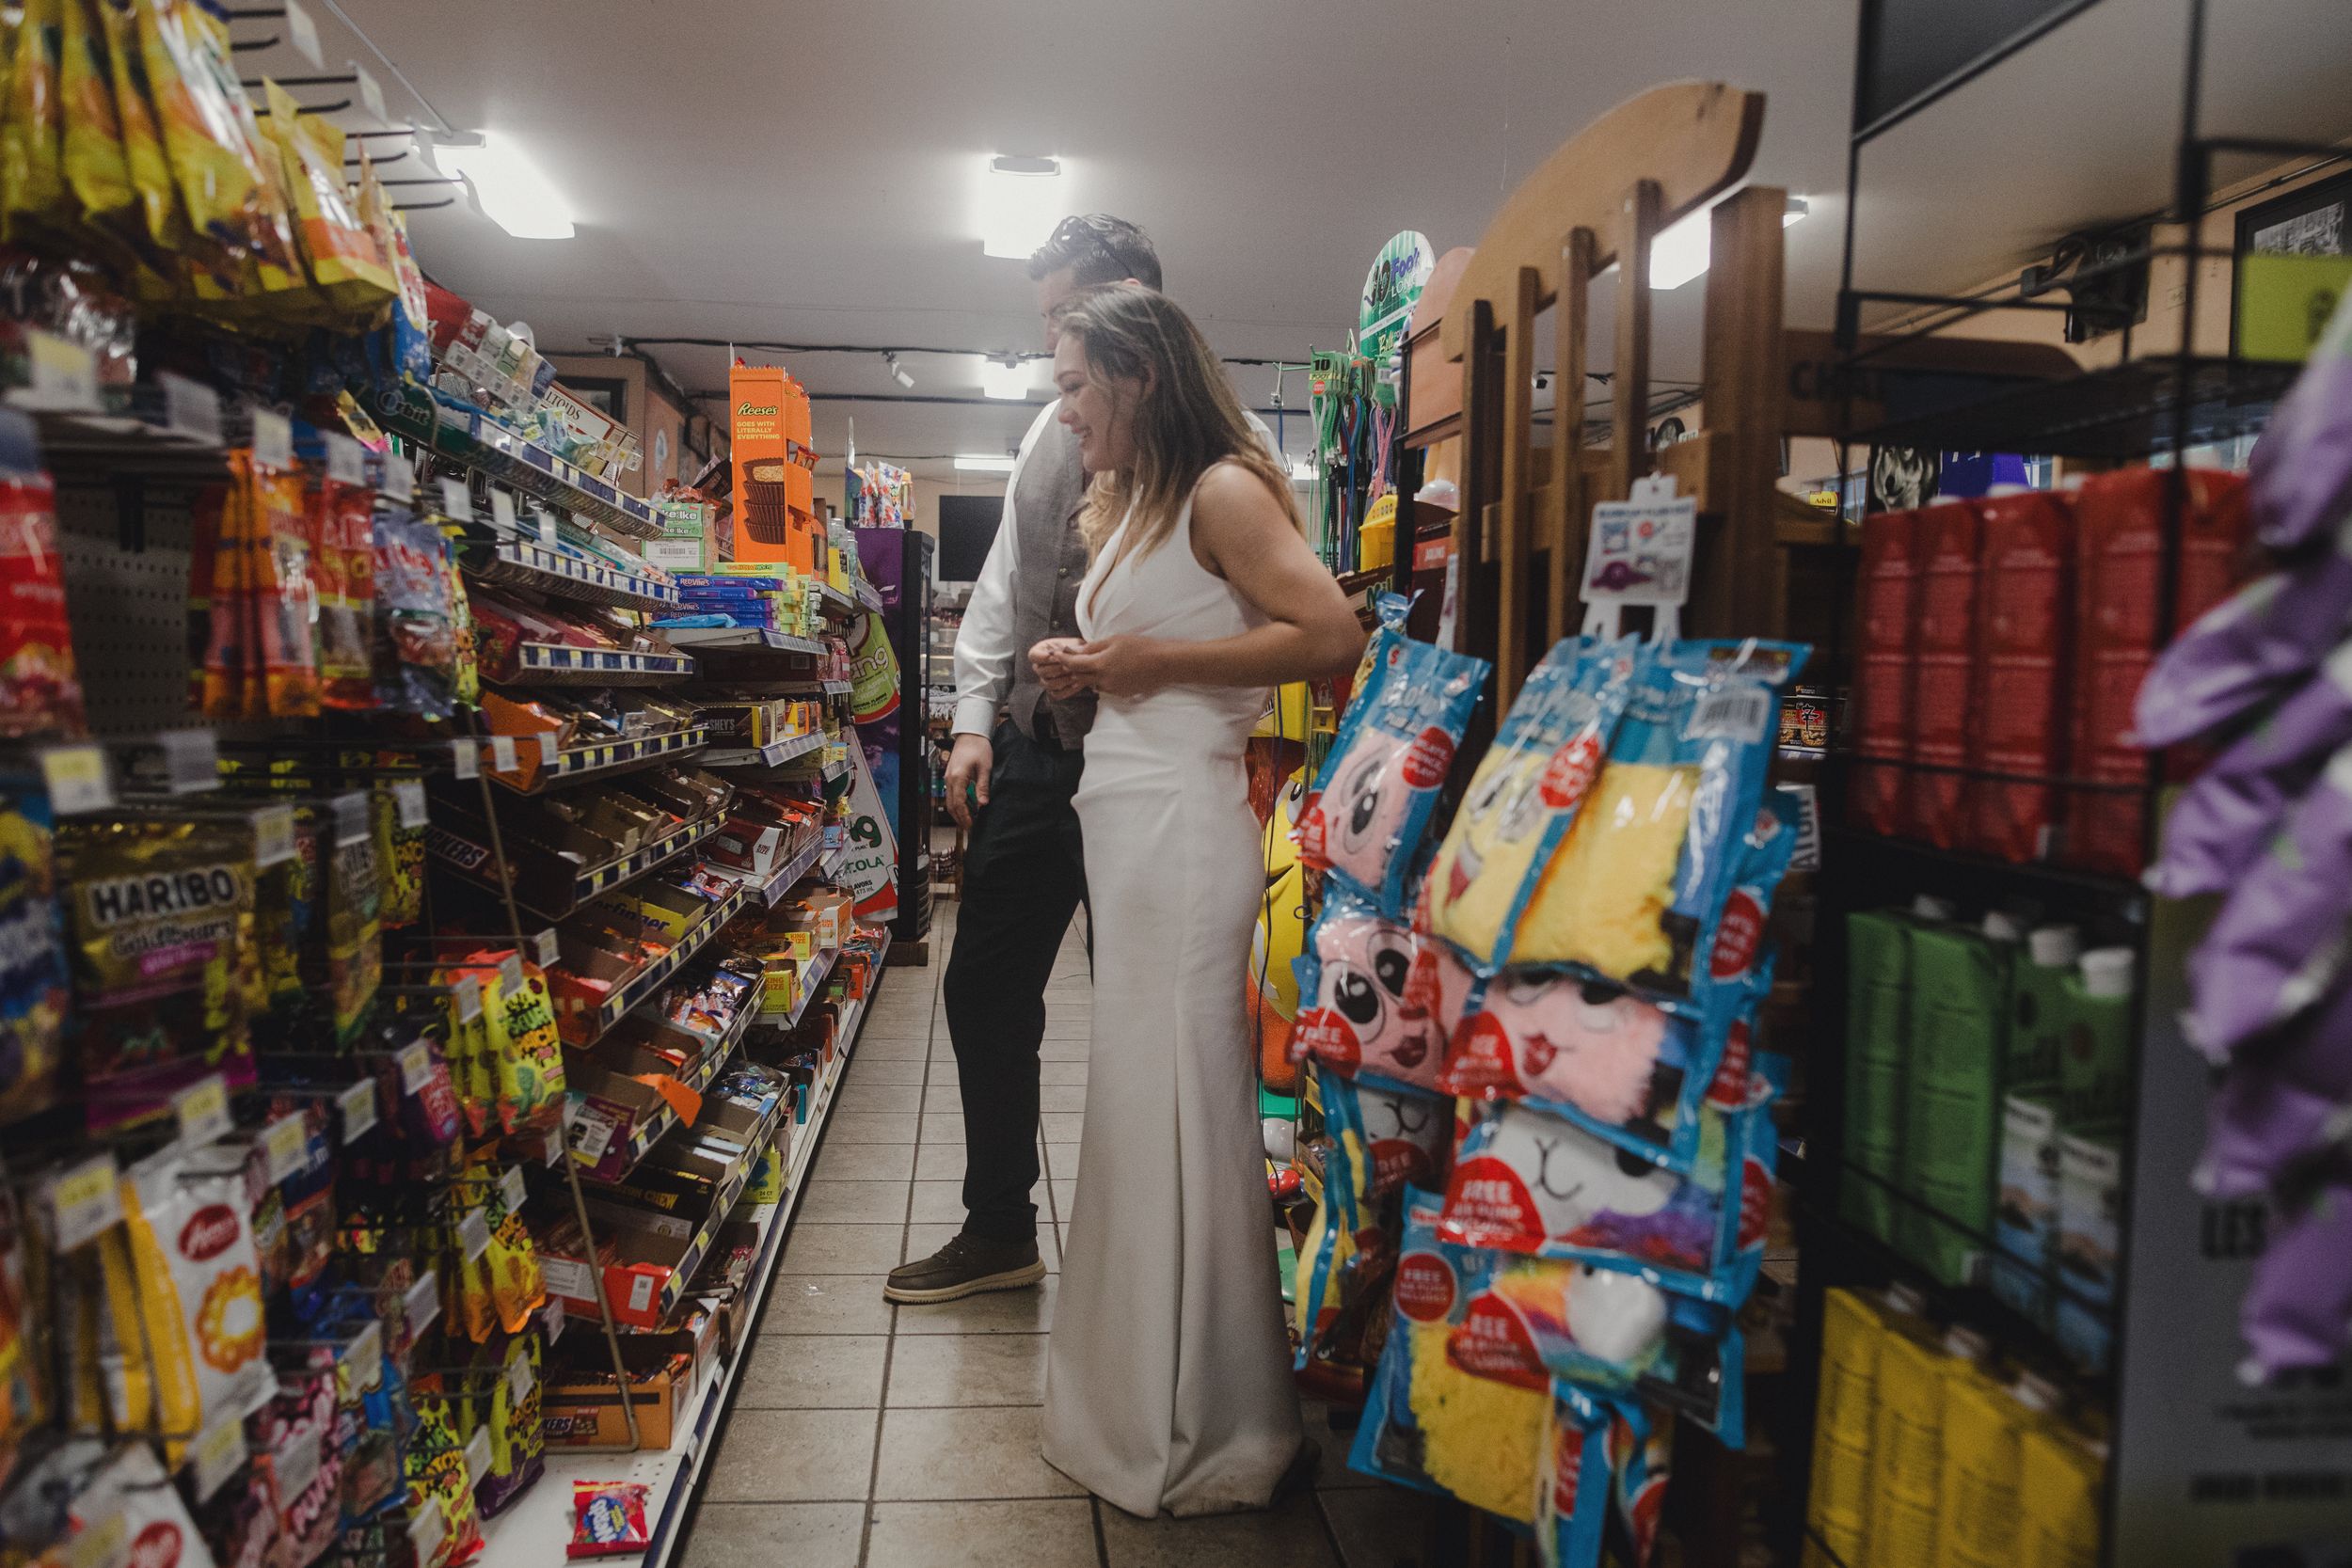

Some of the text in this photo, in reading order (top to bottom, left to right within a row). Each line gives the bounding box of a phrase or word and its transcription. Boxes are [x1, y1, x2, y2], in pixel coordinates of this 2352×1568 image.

[1313, 358, 1331, 372] 10
[546, 391, 580, 420] LTOIDS
[737, 402, 778, 416] Reese's
[707, 719, 735, 731] SHEY'S
[94, 869, 234, 921] HARIBO
